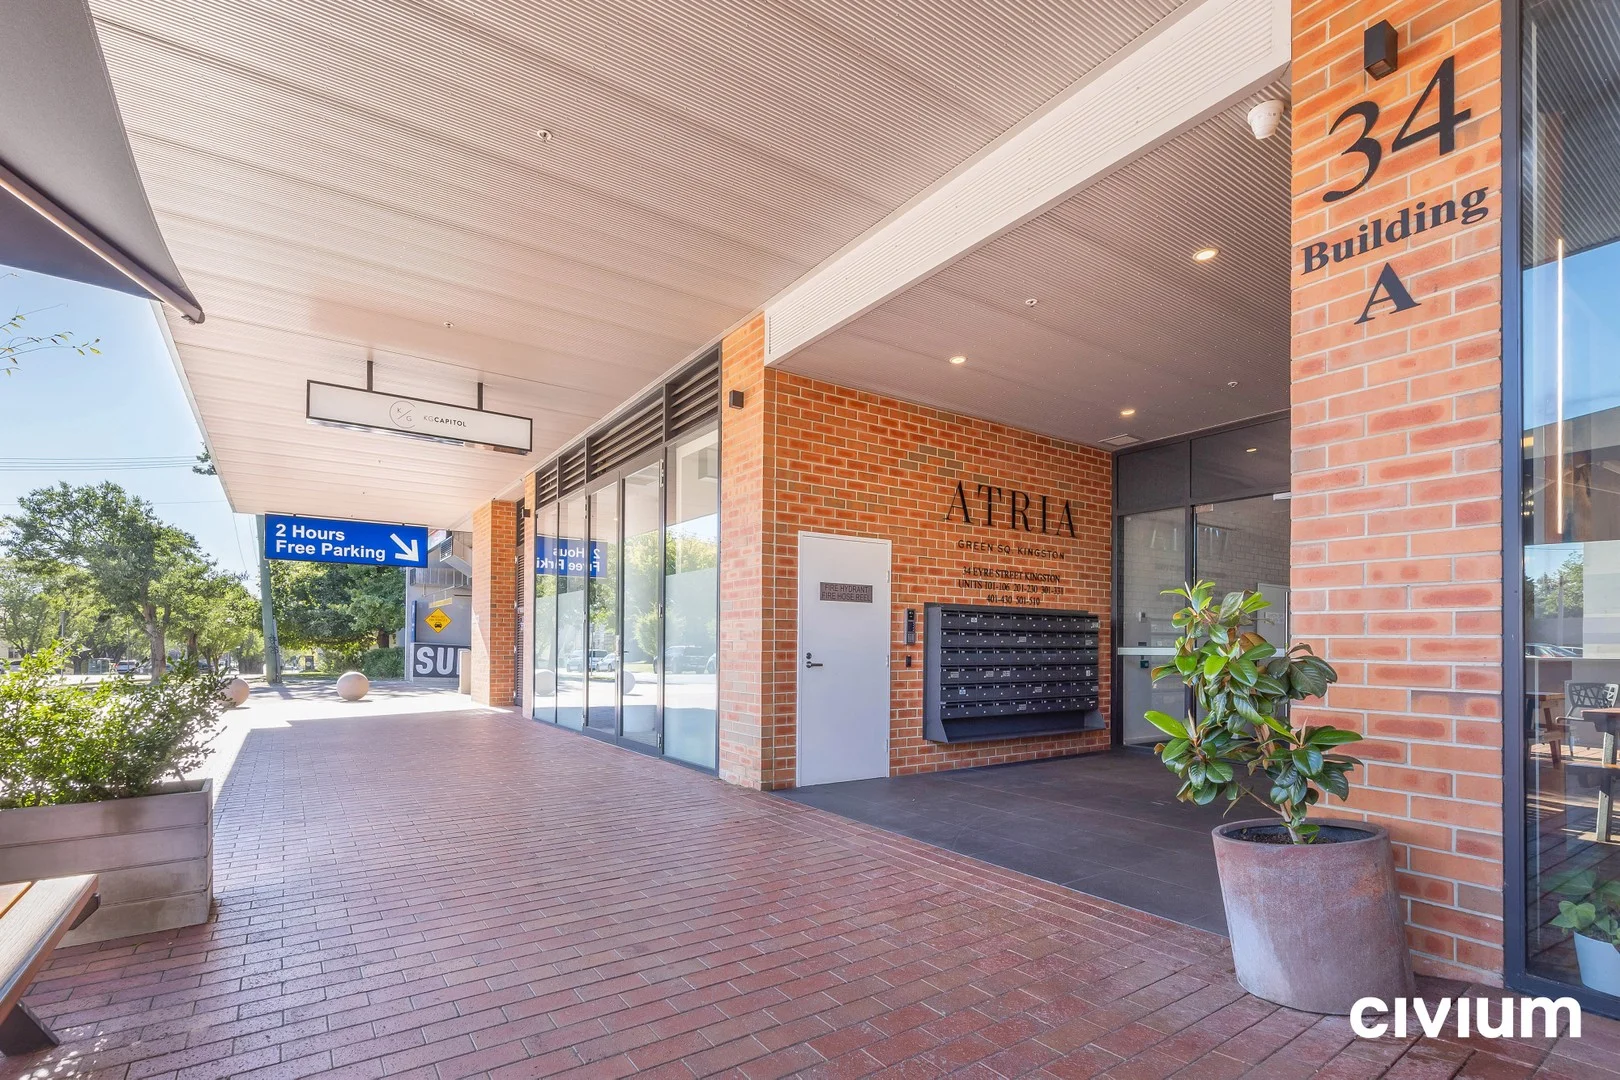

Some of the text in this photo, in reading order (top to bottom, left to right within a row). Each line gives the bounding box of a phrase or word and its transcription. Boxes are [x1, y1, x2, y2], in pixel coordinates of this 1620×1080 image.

[1322, 55, 1471, 203] 34
[1300, 186, 1489, 276] Building
[1353, 262, 1422, 325] A
[943, 479, 1078, 539] ATRIA
[275, 523, 346, 542] 2 Hours
[275, 539, 386, 562] Free Parking
[957, 539, 994, 553] GREEN
[1017, 546, 1065, 560] KINGSTON
[958, 579, 983, 589] UNITS
[984, 581, 1010, 591] 101-106
[1013, 583, 1039, 593] 201-230
[973, 567, 993, 578] EYRE
[995, 569, 1023, 580] STREET
[1024, 572, 1061, 583] KINGSTON
[821, 591, 837, 600] FIRE
[837, 592, 855, 601] HOSE
[824, 584, 868, 593] FIRE HYDRANT
[415, 646, 460, 675] SU
